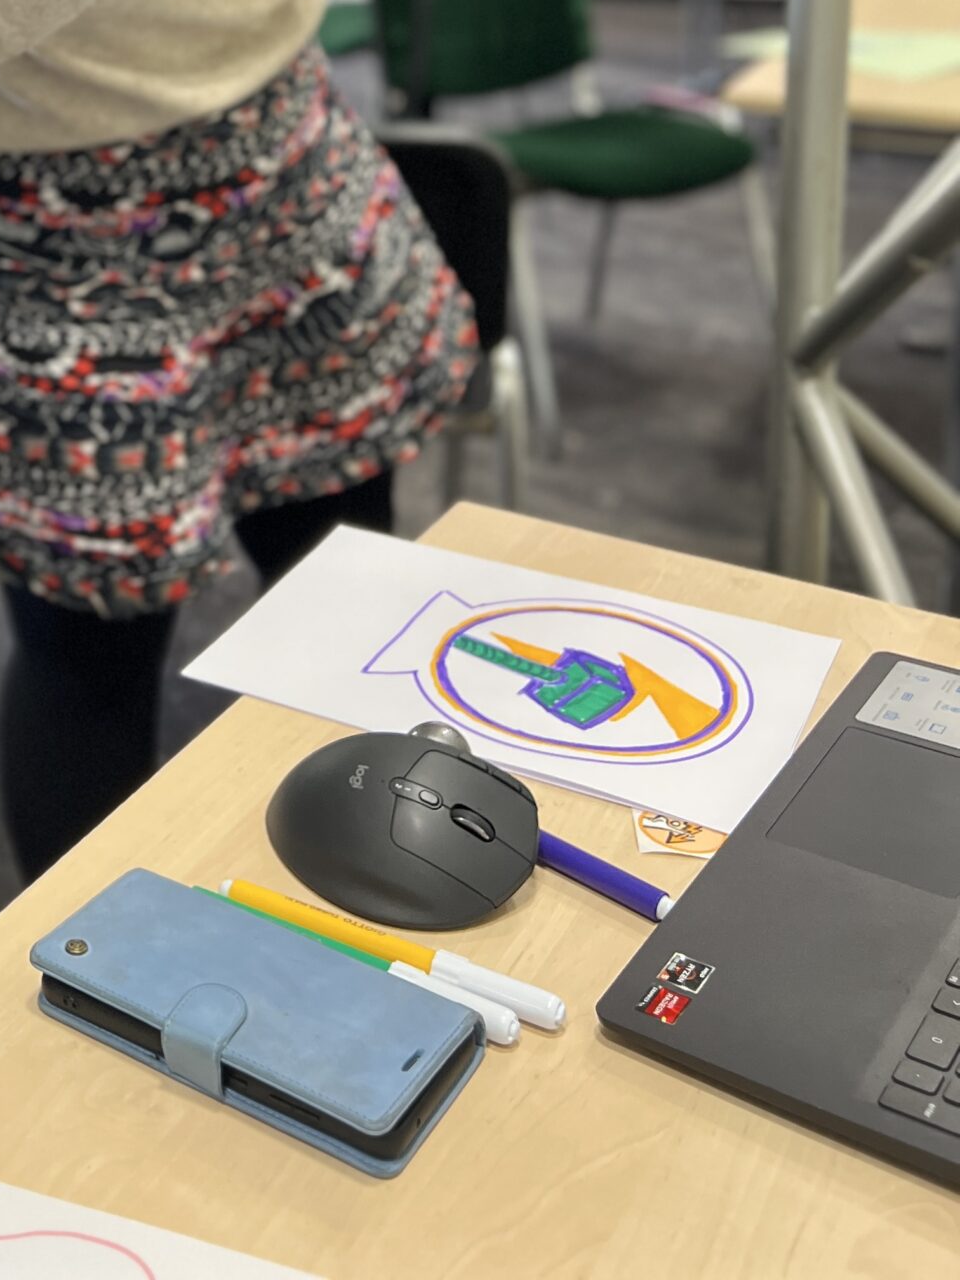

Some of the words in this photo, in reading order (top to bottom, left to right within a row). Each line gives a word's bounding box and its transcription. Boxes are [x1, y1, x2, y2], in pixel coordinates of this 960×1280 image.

[348, 764, 370, 790] logi
[343, 917, 387, 936] GIOTTO
[676, 962, 696, 983] RYZEN
